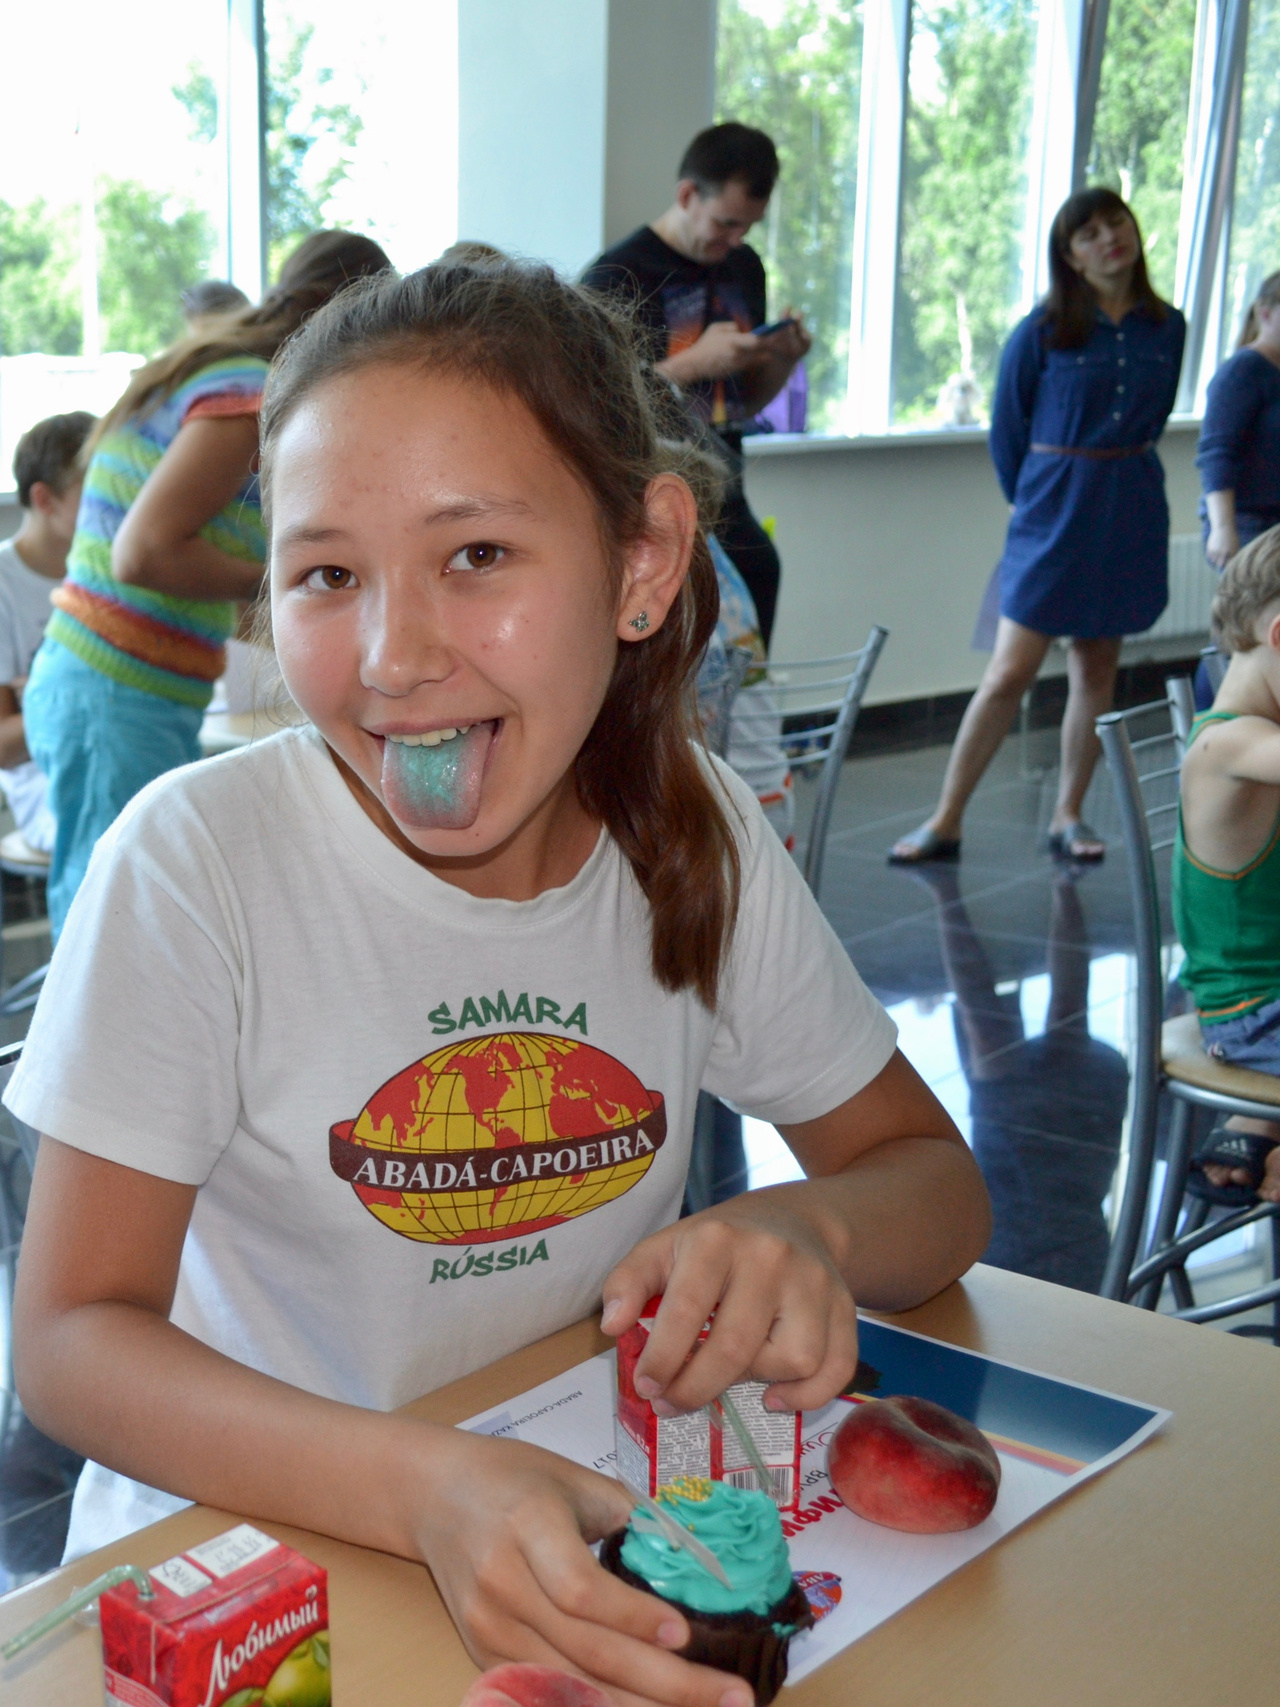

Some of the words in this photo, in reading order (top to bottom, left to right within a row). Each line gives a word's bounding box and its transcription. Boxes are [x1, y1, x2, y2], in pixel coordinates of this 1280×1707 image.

[427, 989, 588, 1036] SAMARA
[352, 1128, 656, 1191] ABADÁ-CAPOEIRA
[429, 1238, 550, 1284] RÚSSIA
[196, 1583, 320, 1707] Любимый
